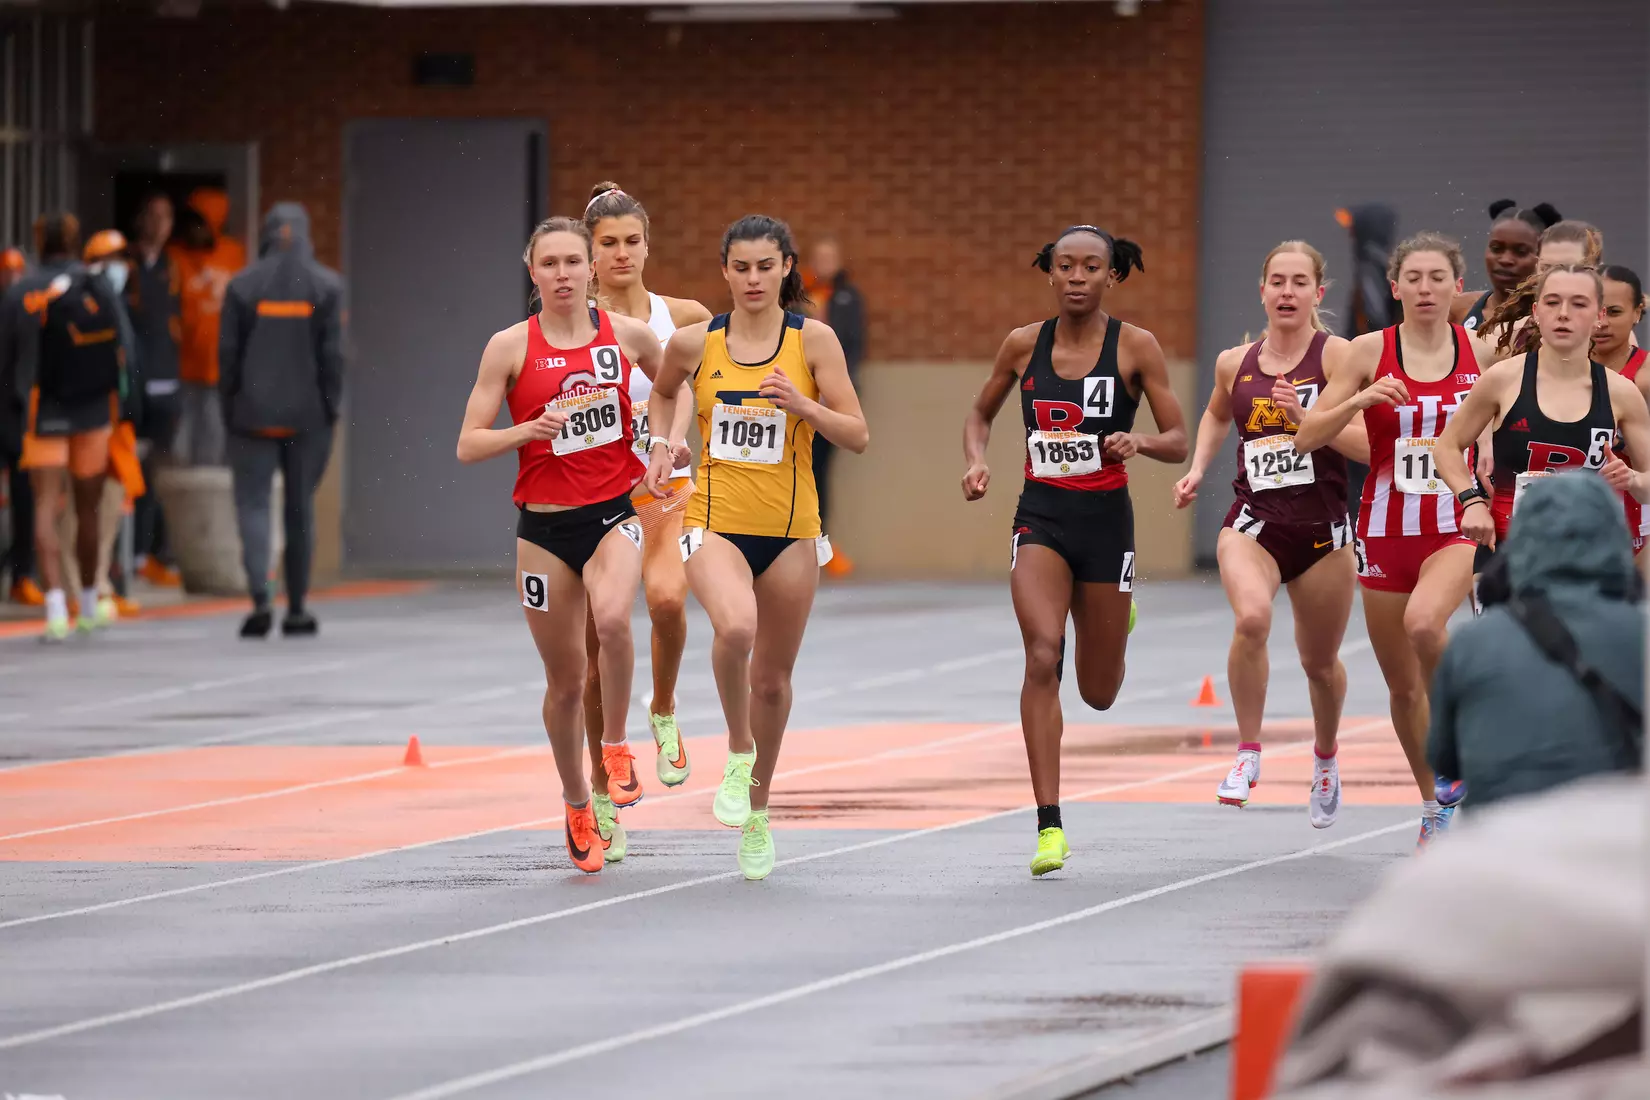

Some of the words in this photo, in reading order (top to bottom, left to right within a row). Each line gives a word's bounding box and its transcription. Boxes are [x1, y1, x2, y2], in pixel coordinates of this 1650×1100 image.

[596, 348, 619, 380] 9
[555, 391, 608, 409] TENNESSEE
[723, 405, 776, 417] TENNESSEE
[1087, 380, 1109, 414] 4
[1296, 387, 1313, 408] 7
[560, 404, 616, 439] 1306
[1033, 400, 1085, 433] R
[1245, 398, 1300, 433] M
[718, 420, 777, 449] 1091
[1252, 435, 1294, 448] TENNESS
[1406, 439, 1436, 447] TENNE
[1590, 431, 1609, 466] 3
[1035, 440, 1094, 464] 1853
[1251, 447, 1308, 477] 1252
[1527, 441, 1587, 472] R
[681, 534, 692, 556] 1
[1123, 555, 1134, 589] 4
[525, 575, 545, 608] 9
